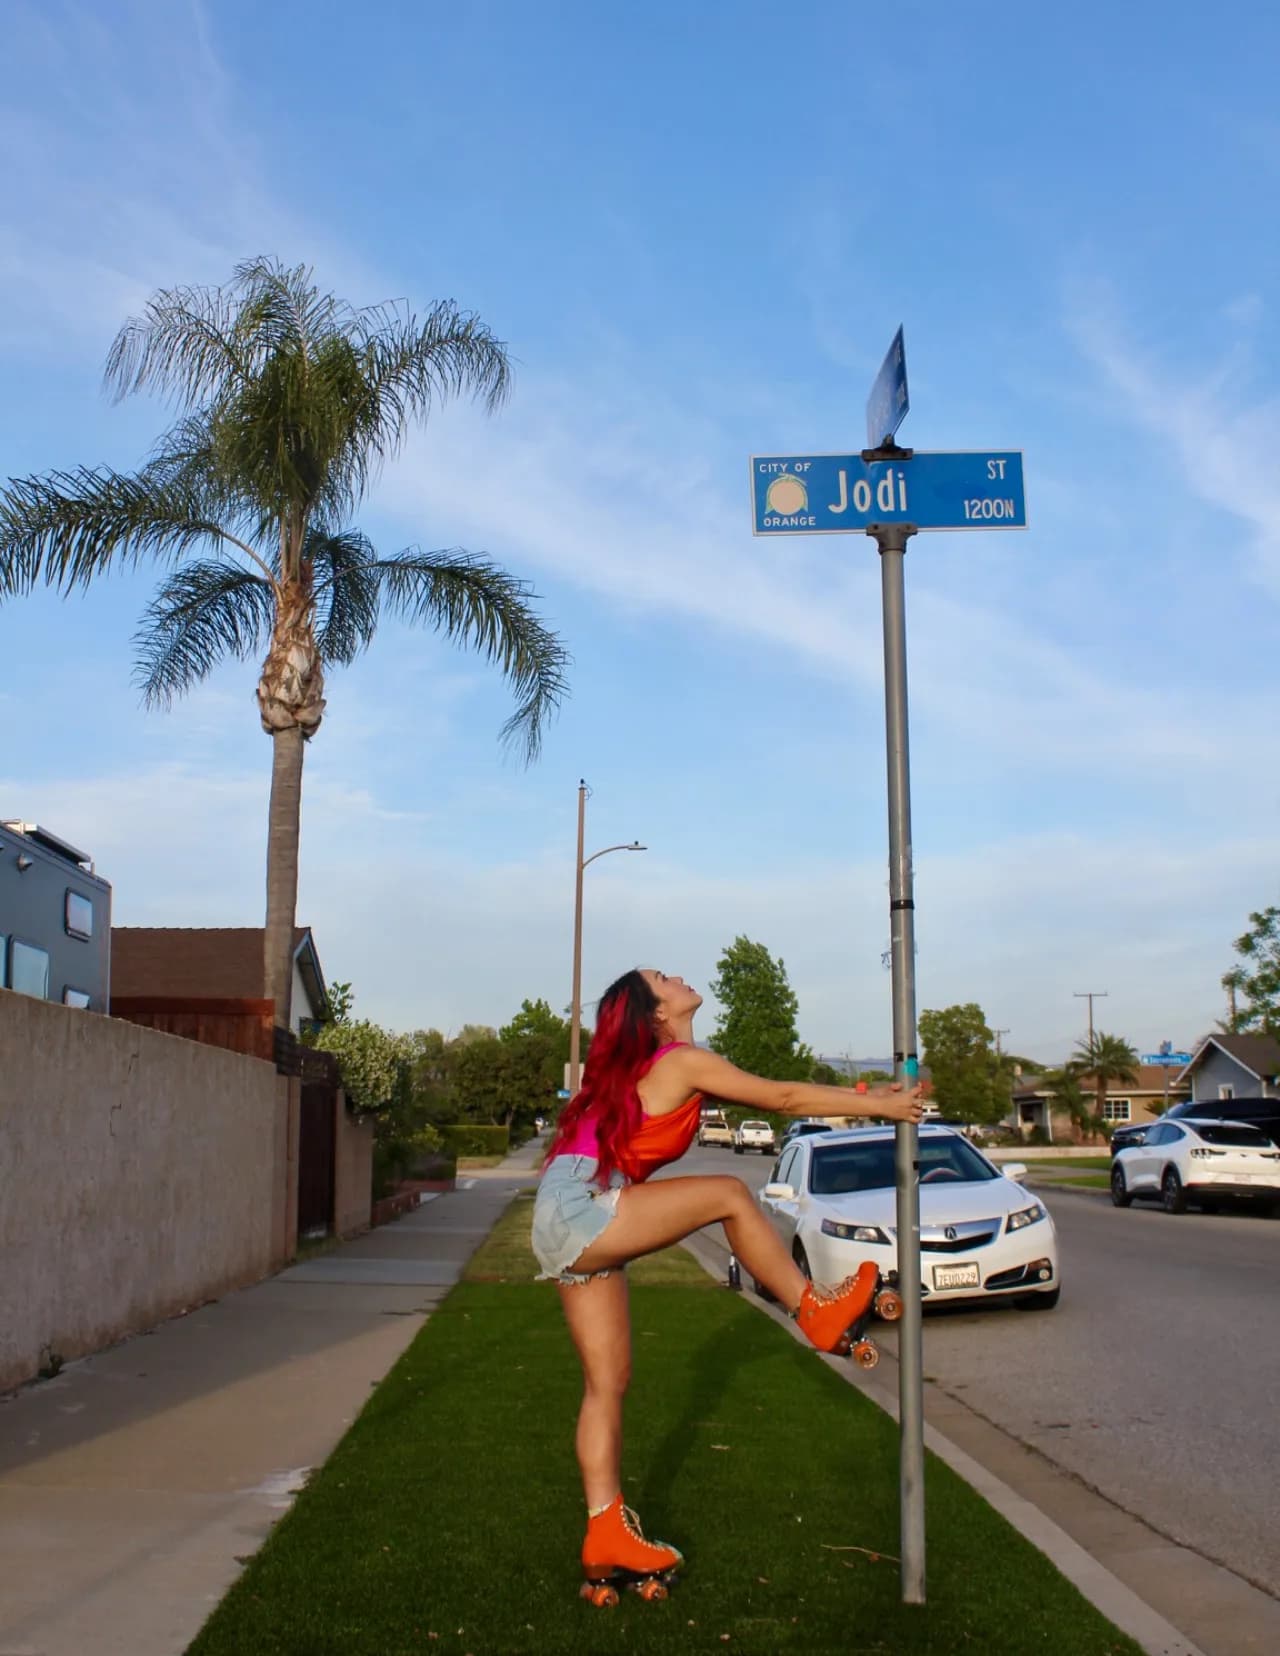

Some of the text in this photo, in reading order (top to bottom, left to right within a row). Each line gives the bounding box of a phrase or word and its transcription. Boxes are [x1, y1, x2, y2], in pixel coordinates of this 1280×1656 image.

[759, 462, 812, 473] CITY OF
[987, 459, 1007, 480] ST
[827, 468, 907, 514] Jodi
[963, 498, 1015, 519] 1200N
[763, 516, 816, 527] ORANGE
